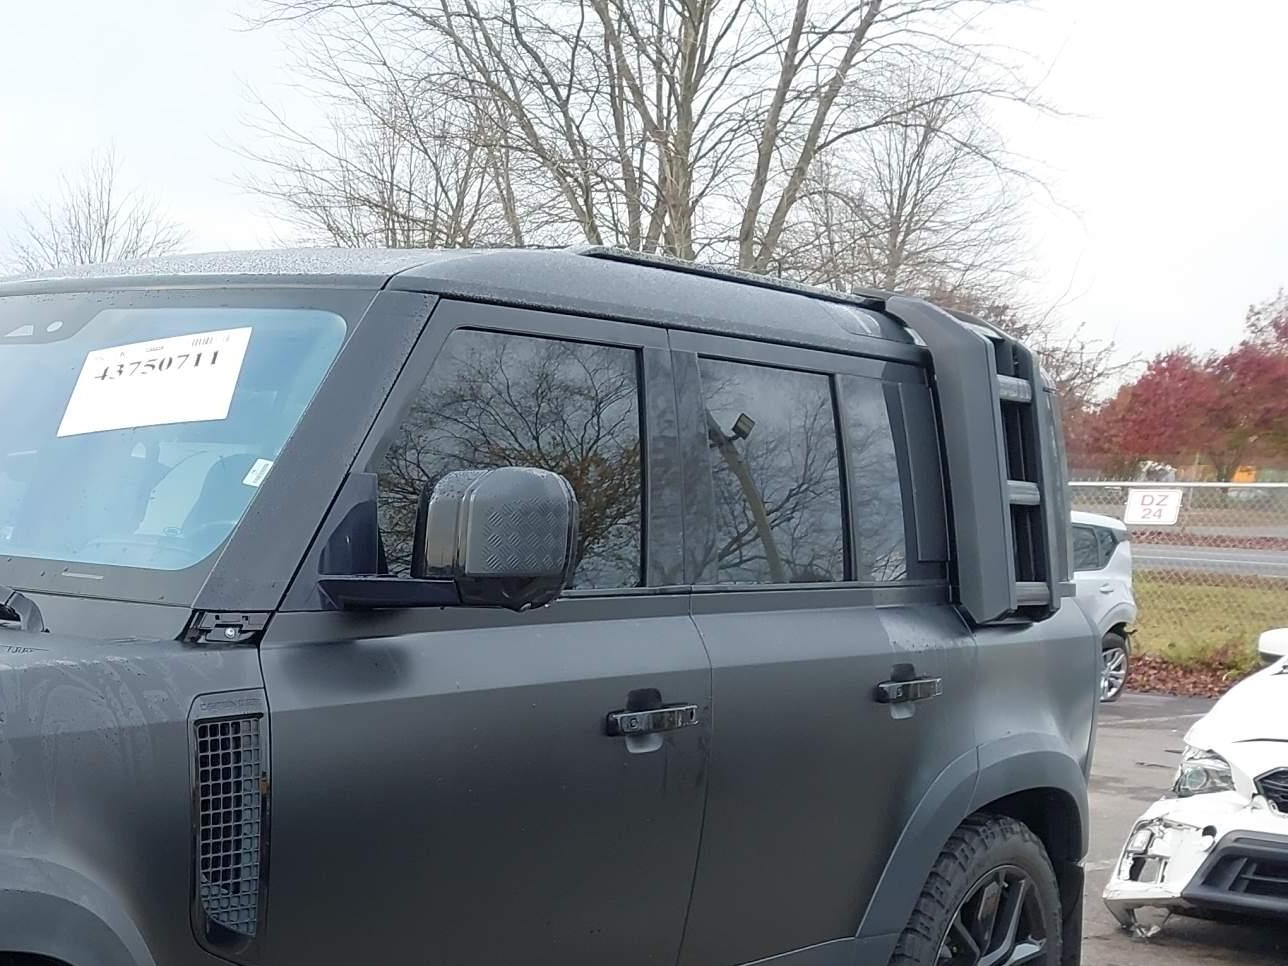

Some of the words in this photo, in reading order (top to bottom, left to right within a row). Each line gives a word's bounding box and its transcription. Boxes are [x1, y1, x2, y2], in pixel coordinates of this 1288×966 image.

[94, 350, 220, 381] 43750711
[1141, 494, 1169, 507] DZ
[1141, 507, 1163, 520] 24
